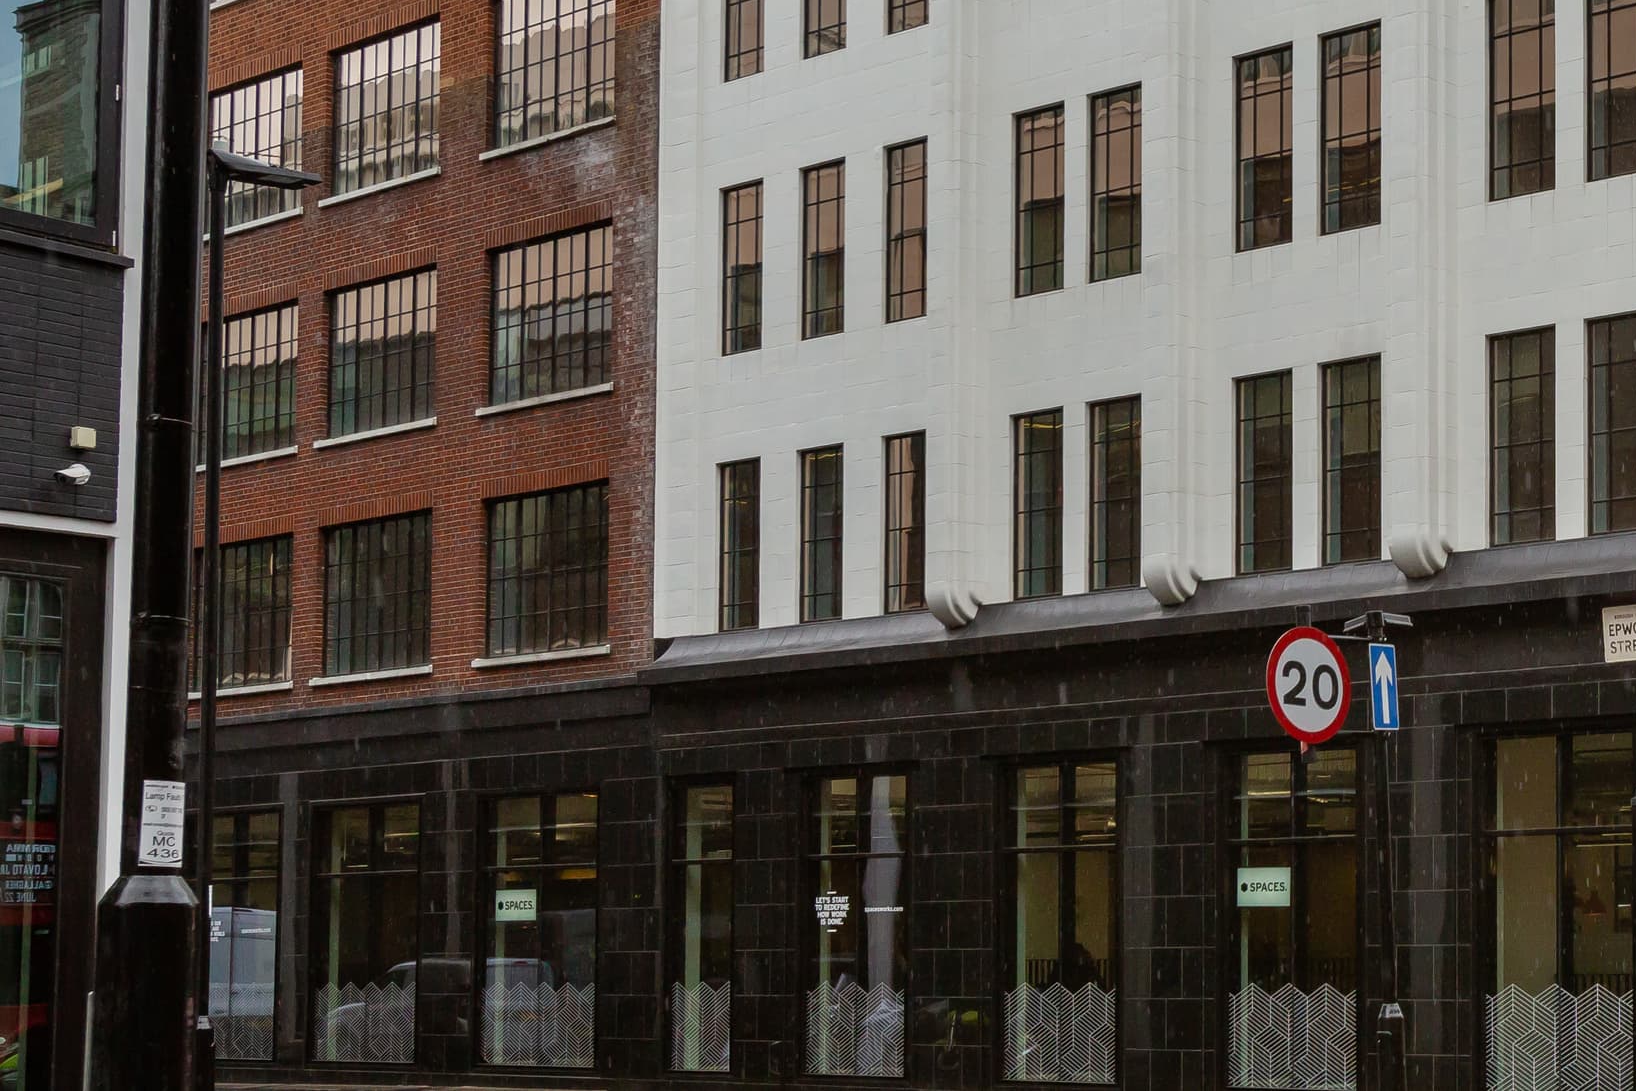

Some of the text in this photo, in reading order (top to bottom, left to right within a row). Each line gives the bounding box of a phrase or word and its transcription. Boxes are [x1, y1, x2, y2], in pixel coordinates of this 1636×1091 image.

[1281, 660, 1340, 711] 20
[145, 792, 165, 801] Lamp
[152, 836, 176, 847] MC
[146, 848, 179, 859] 436
[1249, 881, 1288, 893] SPACES.
[831, 896, 849, 904] START
[815, 903, 823, 911] TO
[831, 910, 848, 918] WORK
[820, 918, 827, 926] IS
